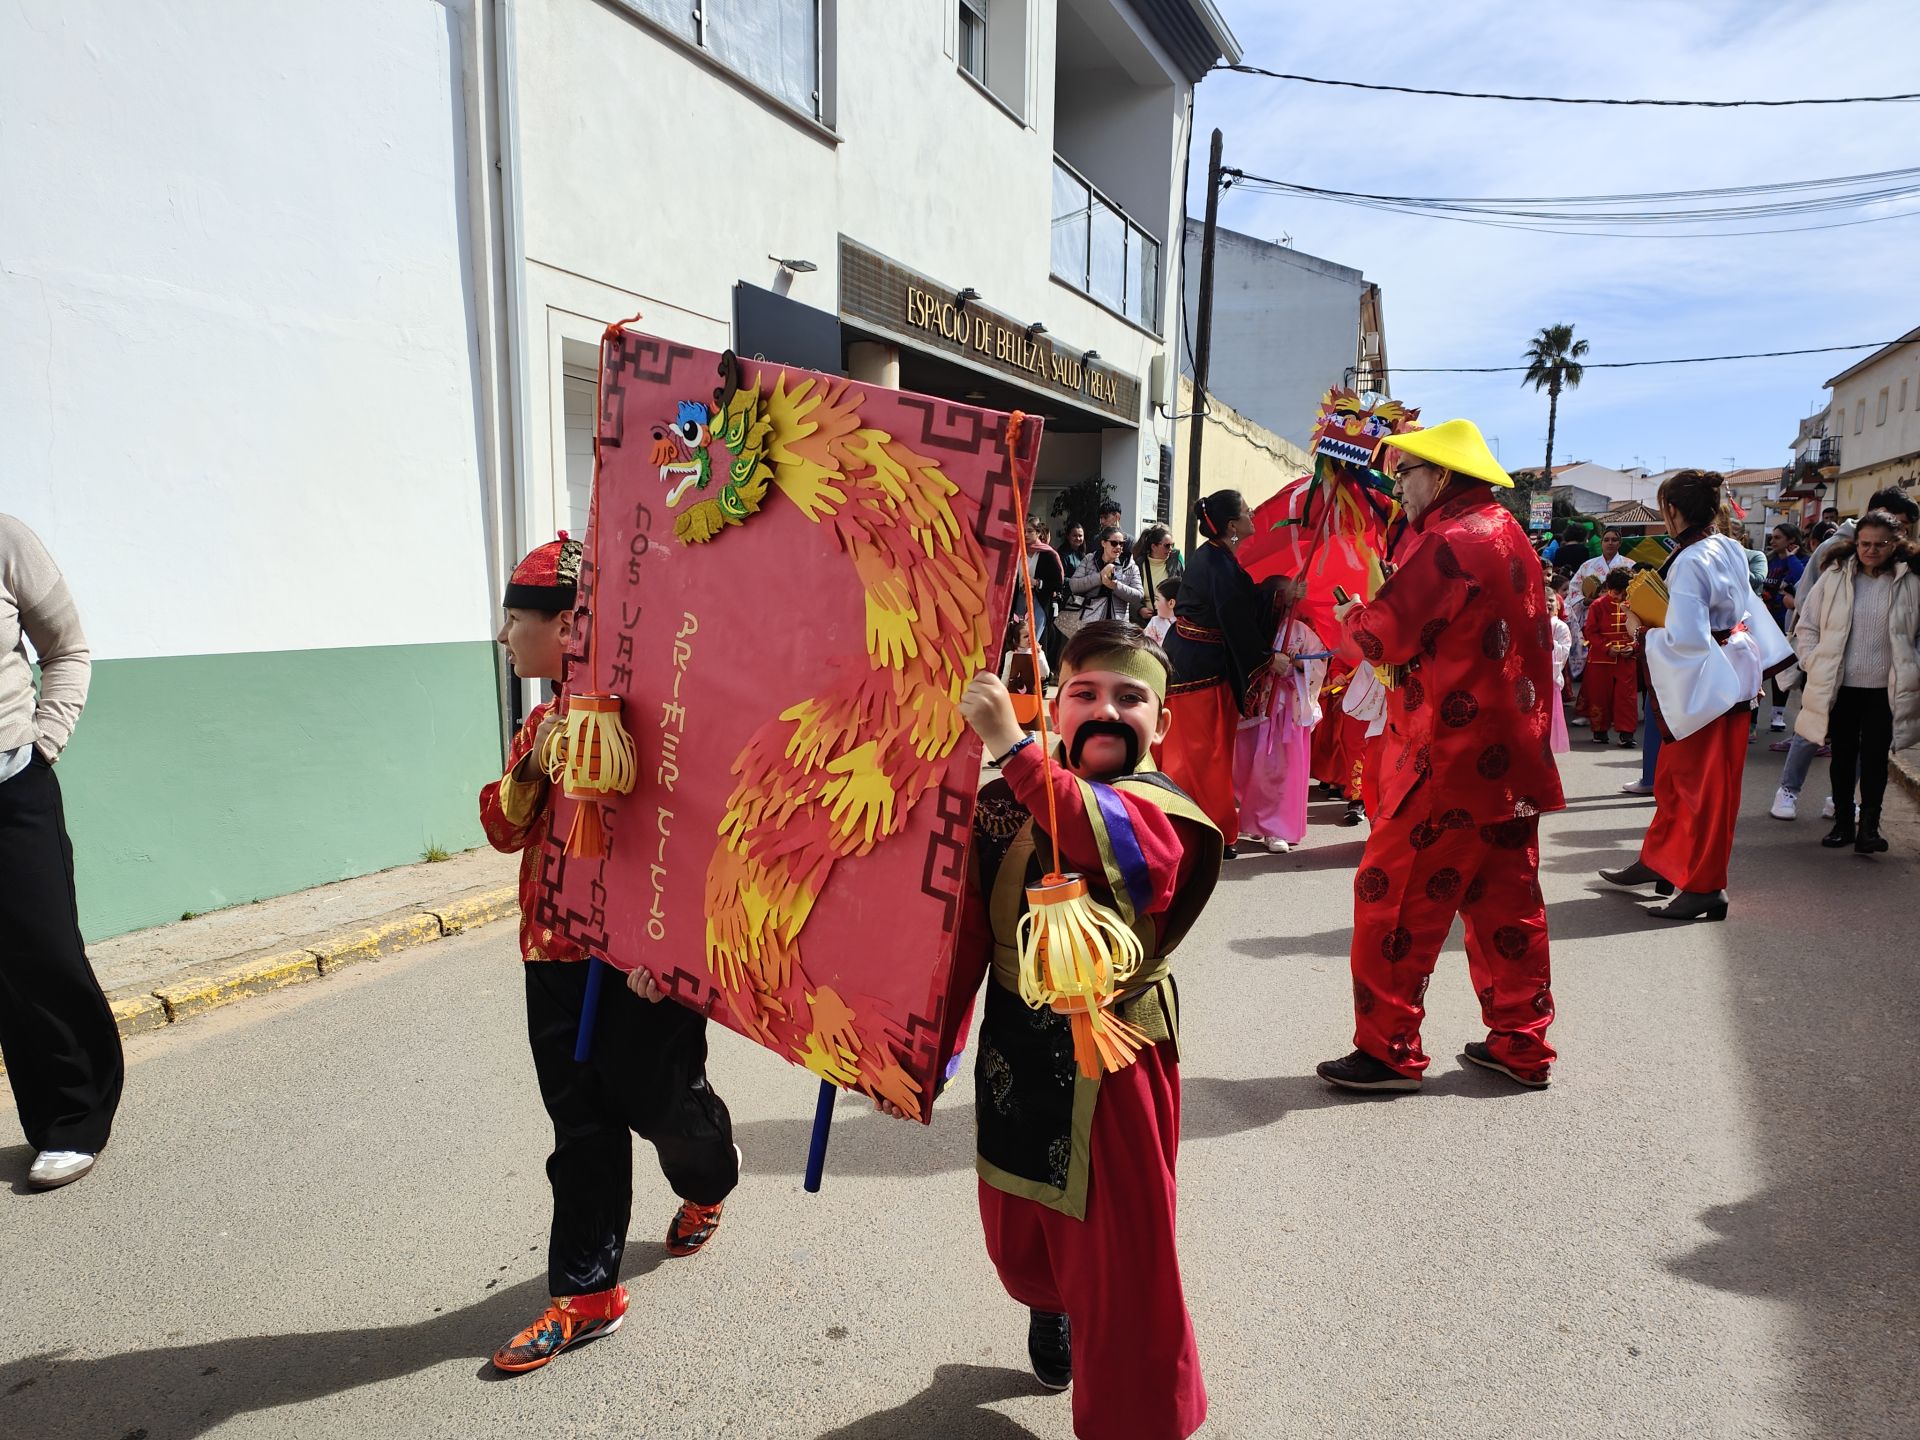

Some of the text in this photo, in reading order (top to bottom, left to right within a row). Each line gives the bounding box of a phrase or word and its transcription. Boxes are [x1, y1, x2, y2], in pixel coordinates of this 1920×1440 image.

[906, 286, 1118, 406] ESPACIO DE BELLEZA, SALUD Y RELAX
[608, 601, 642, 694] VAM
[646, 611, 699, 941] PRIMER CICLO
